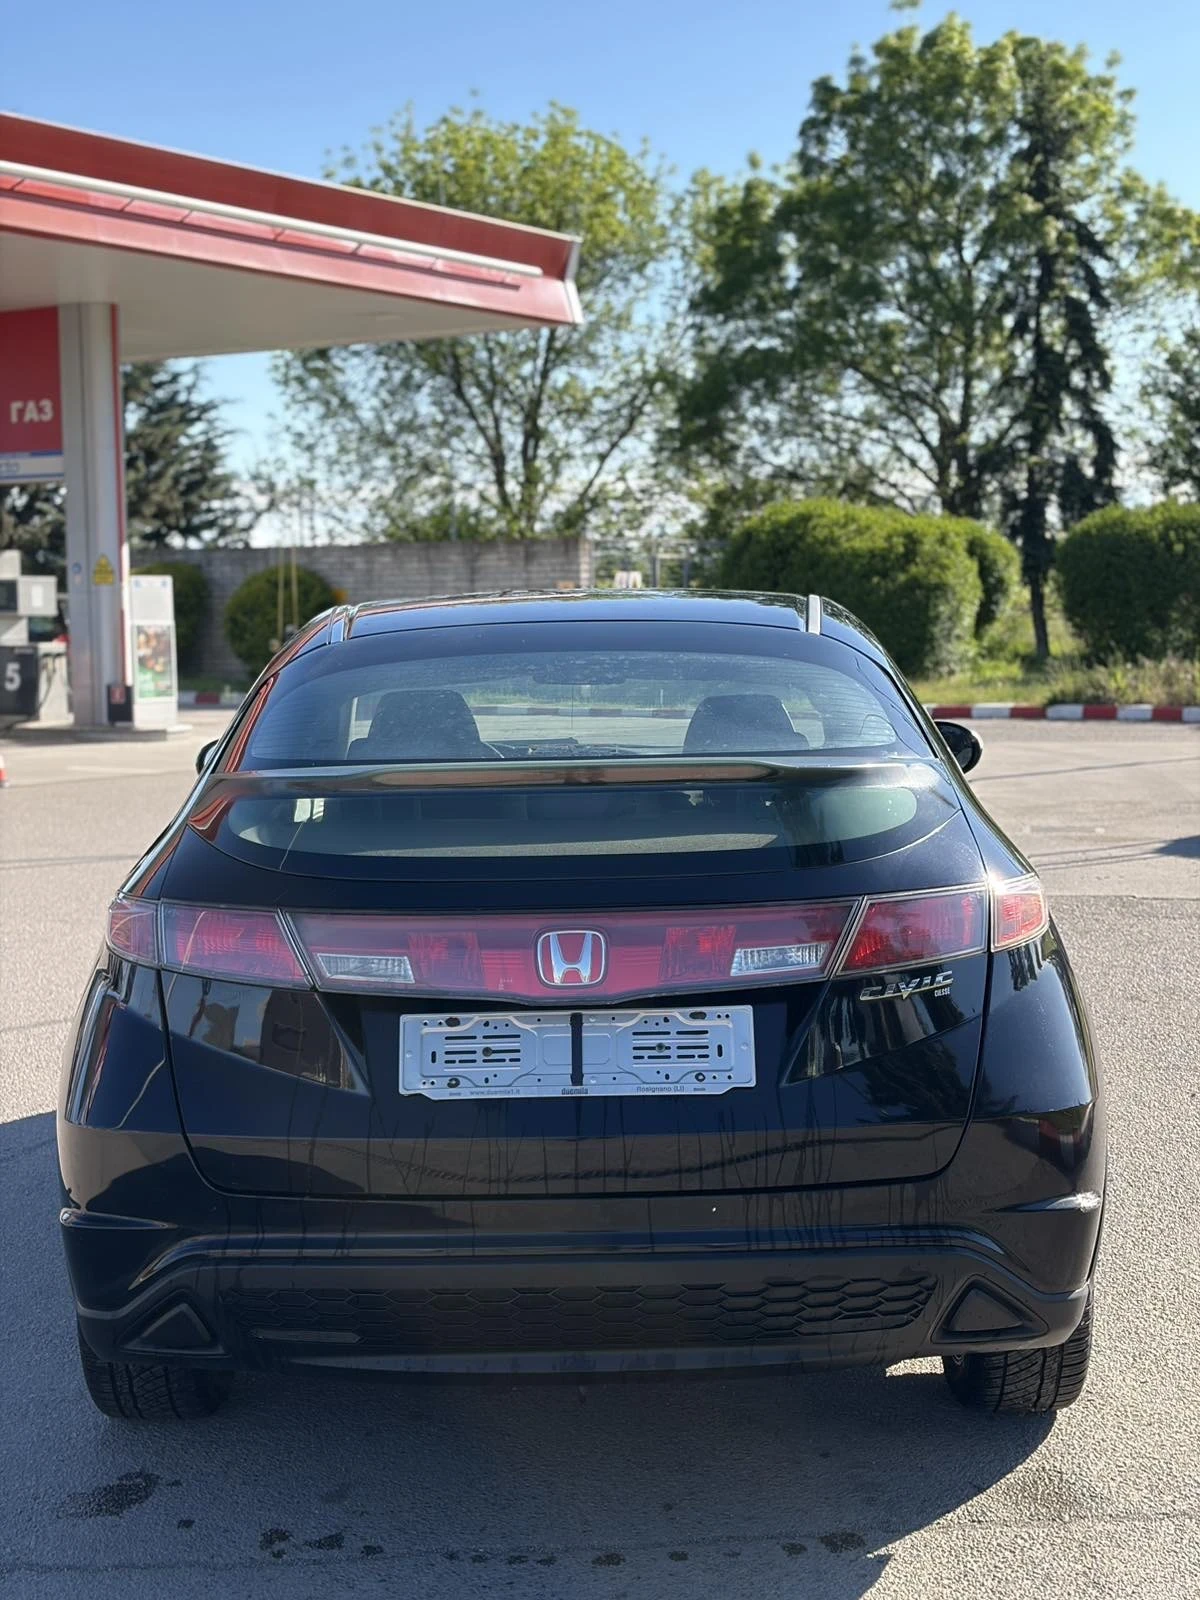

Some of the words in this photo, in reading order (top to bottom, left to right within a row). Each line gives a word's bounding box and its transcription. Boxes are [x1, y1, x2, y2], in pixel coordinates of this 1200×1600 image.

[10, 398, 53, 424] ГАЗ
[5, 662, 21, 691] 5
[860, 970, 954, 1000] CIVIC
